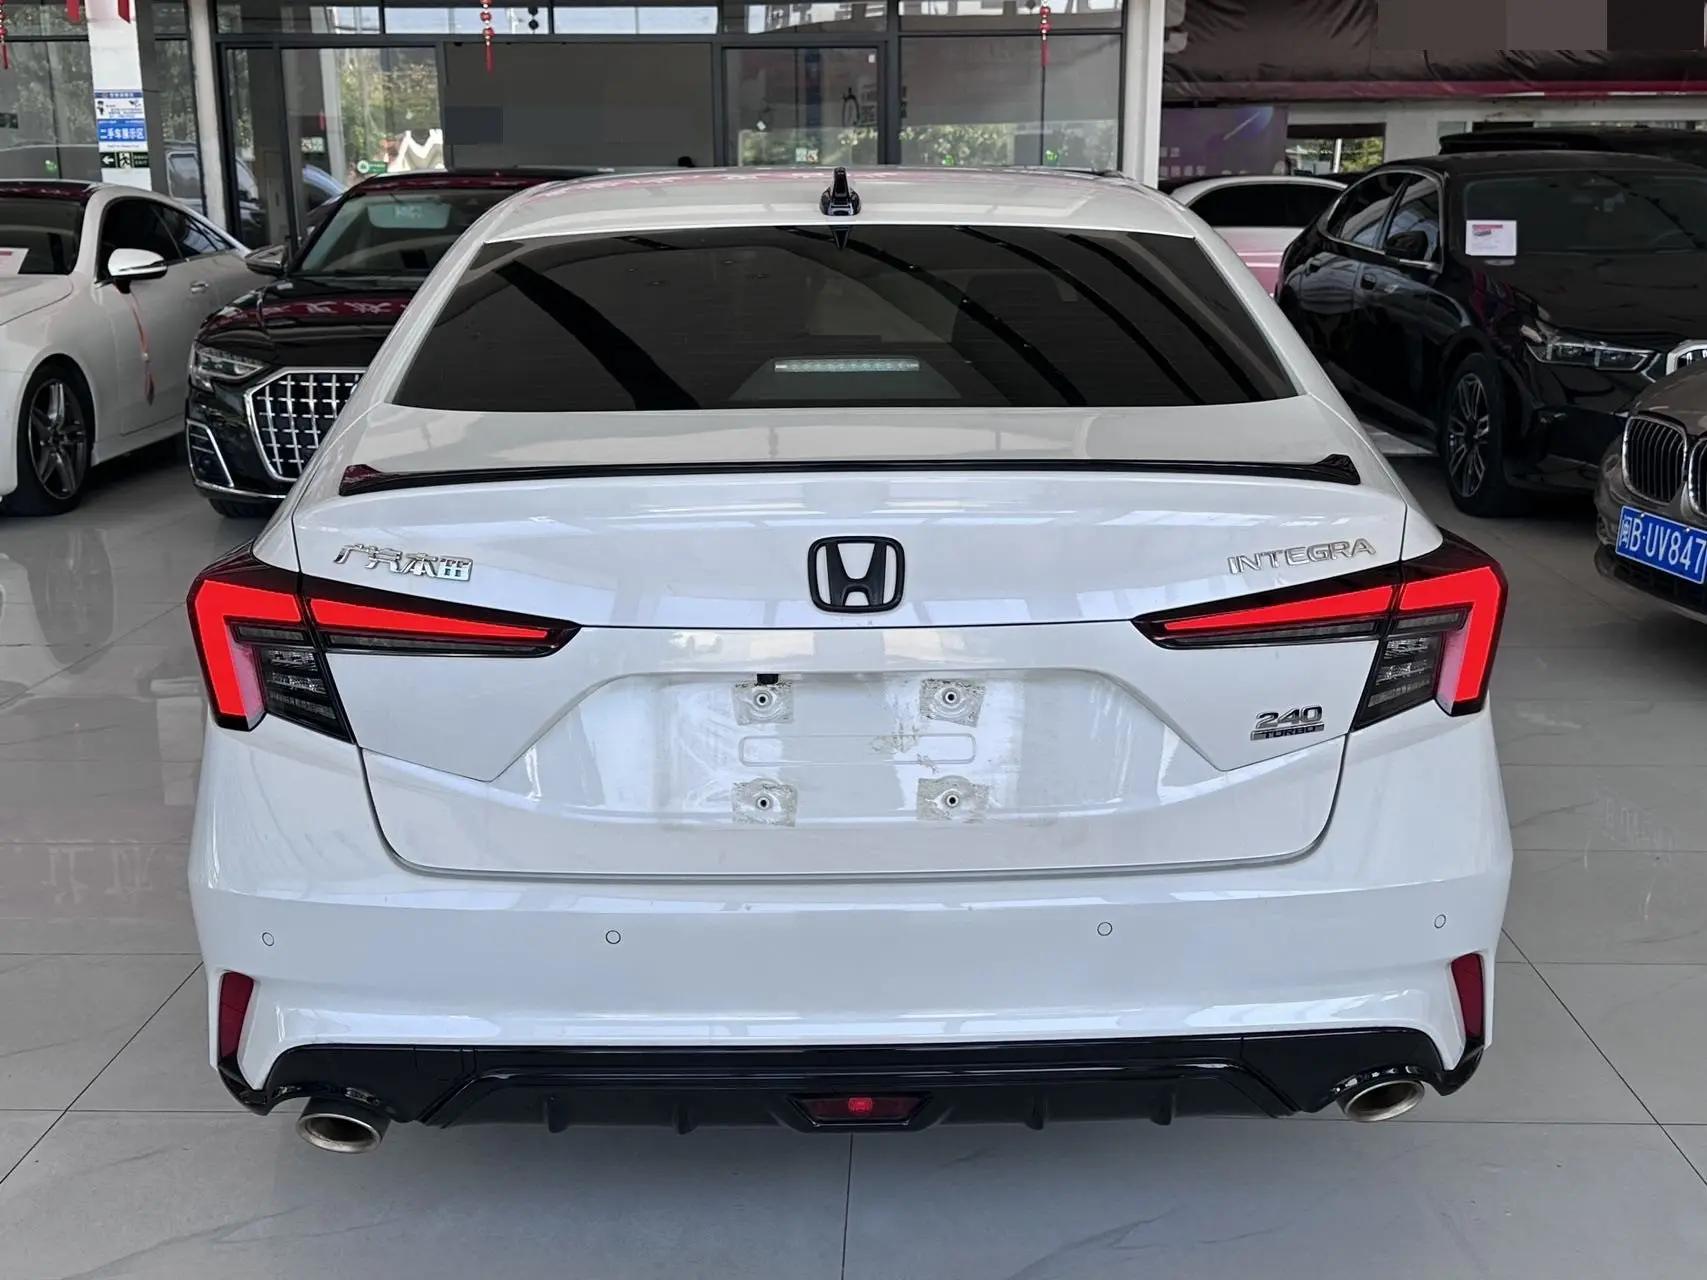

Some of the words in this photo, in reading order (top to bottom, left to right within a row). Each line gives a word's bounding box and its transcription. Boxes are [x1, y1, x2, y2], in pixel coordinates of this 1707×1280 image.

[100, 127, 145, 140] 二手车展示区
[333, 543, 474, 582] 广汽本田
[1227, 537, 1377, 575] INTEGRA
[1255, 706, 1323, 730] 240
